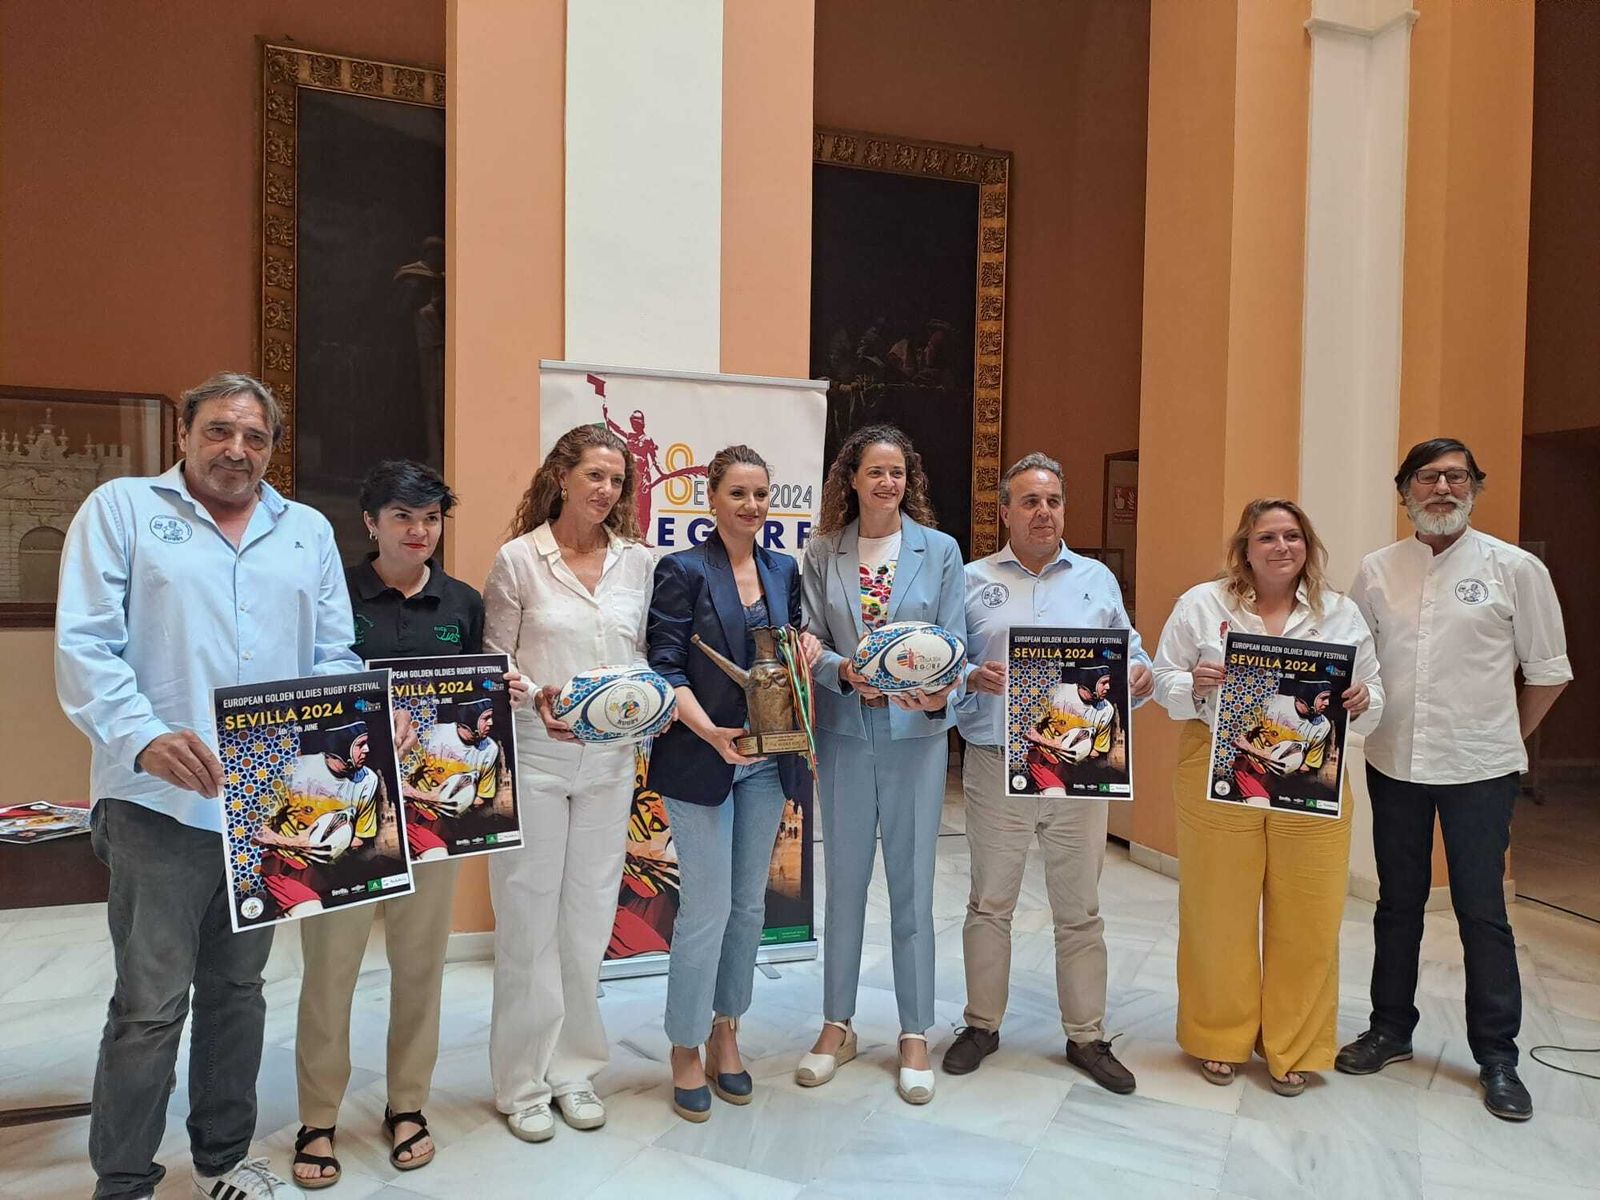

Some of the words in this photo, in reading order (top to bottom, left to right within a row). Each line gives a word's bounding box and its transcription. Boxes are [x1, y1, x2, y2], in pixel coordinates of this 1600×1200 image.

[769, 484, 812, 509] 2024
[658, 517, 811, 549] EGRF
[1014, 635, 1040, 643] EUROPEAN
[1041, 636, 1061, 644] GOLDEN
[1062, 636, 1080, 644] OLDIES
[1081, 636, 1098, 644] RUGBY
[1099, 637, 1122, 645] FESTIVAL
[1014, 647, 1062, 658] SEVILLA
[1064, 648, 1094, 659] 2024
[1232, 641, 1260, 651] EUROPEAN
[1261, 644, 1282, 653] GOLDEN
[1283, 647, 1303, 656] OLDIES
[1304, 649, 1322, 658] RUGBY
[1323, 651, 1348, 661] FESTIVAL
[391, 669, 408, 679] PEAN
[410, 668, 433, 678] GOLDEN
[434, 667, 455, 676] OLDIES
[457, 666, 476, 675] RUGBY
[477, 665, 502, 674] FESTIVAL
[1230, 653, 1281, 668] SEVILLA
[1284, 659, 1316, 673] 2024
[223, 694, 263, 709] EUROPEAN
[265, 691, 295, 703] GOLDEN
[296, 688, 322, 700] OLDIES
[323, 685, 347, 696] RUGBY
[349, 681, 380, 692] FESTIVAL
[438, 680, 473, 694] 2024
[225, 708, 298, 730] SEVILLA
[301, 701, 344, 721] 2024
[303, 723, 319, 732] JUNE
